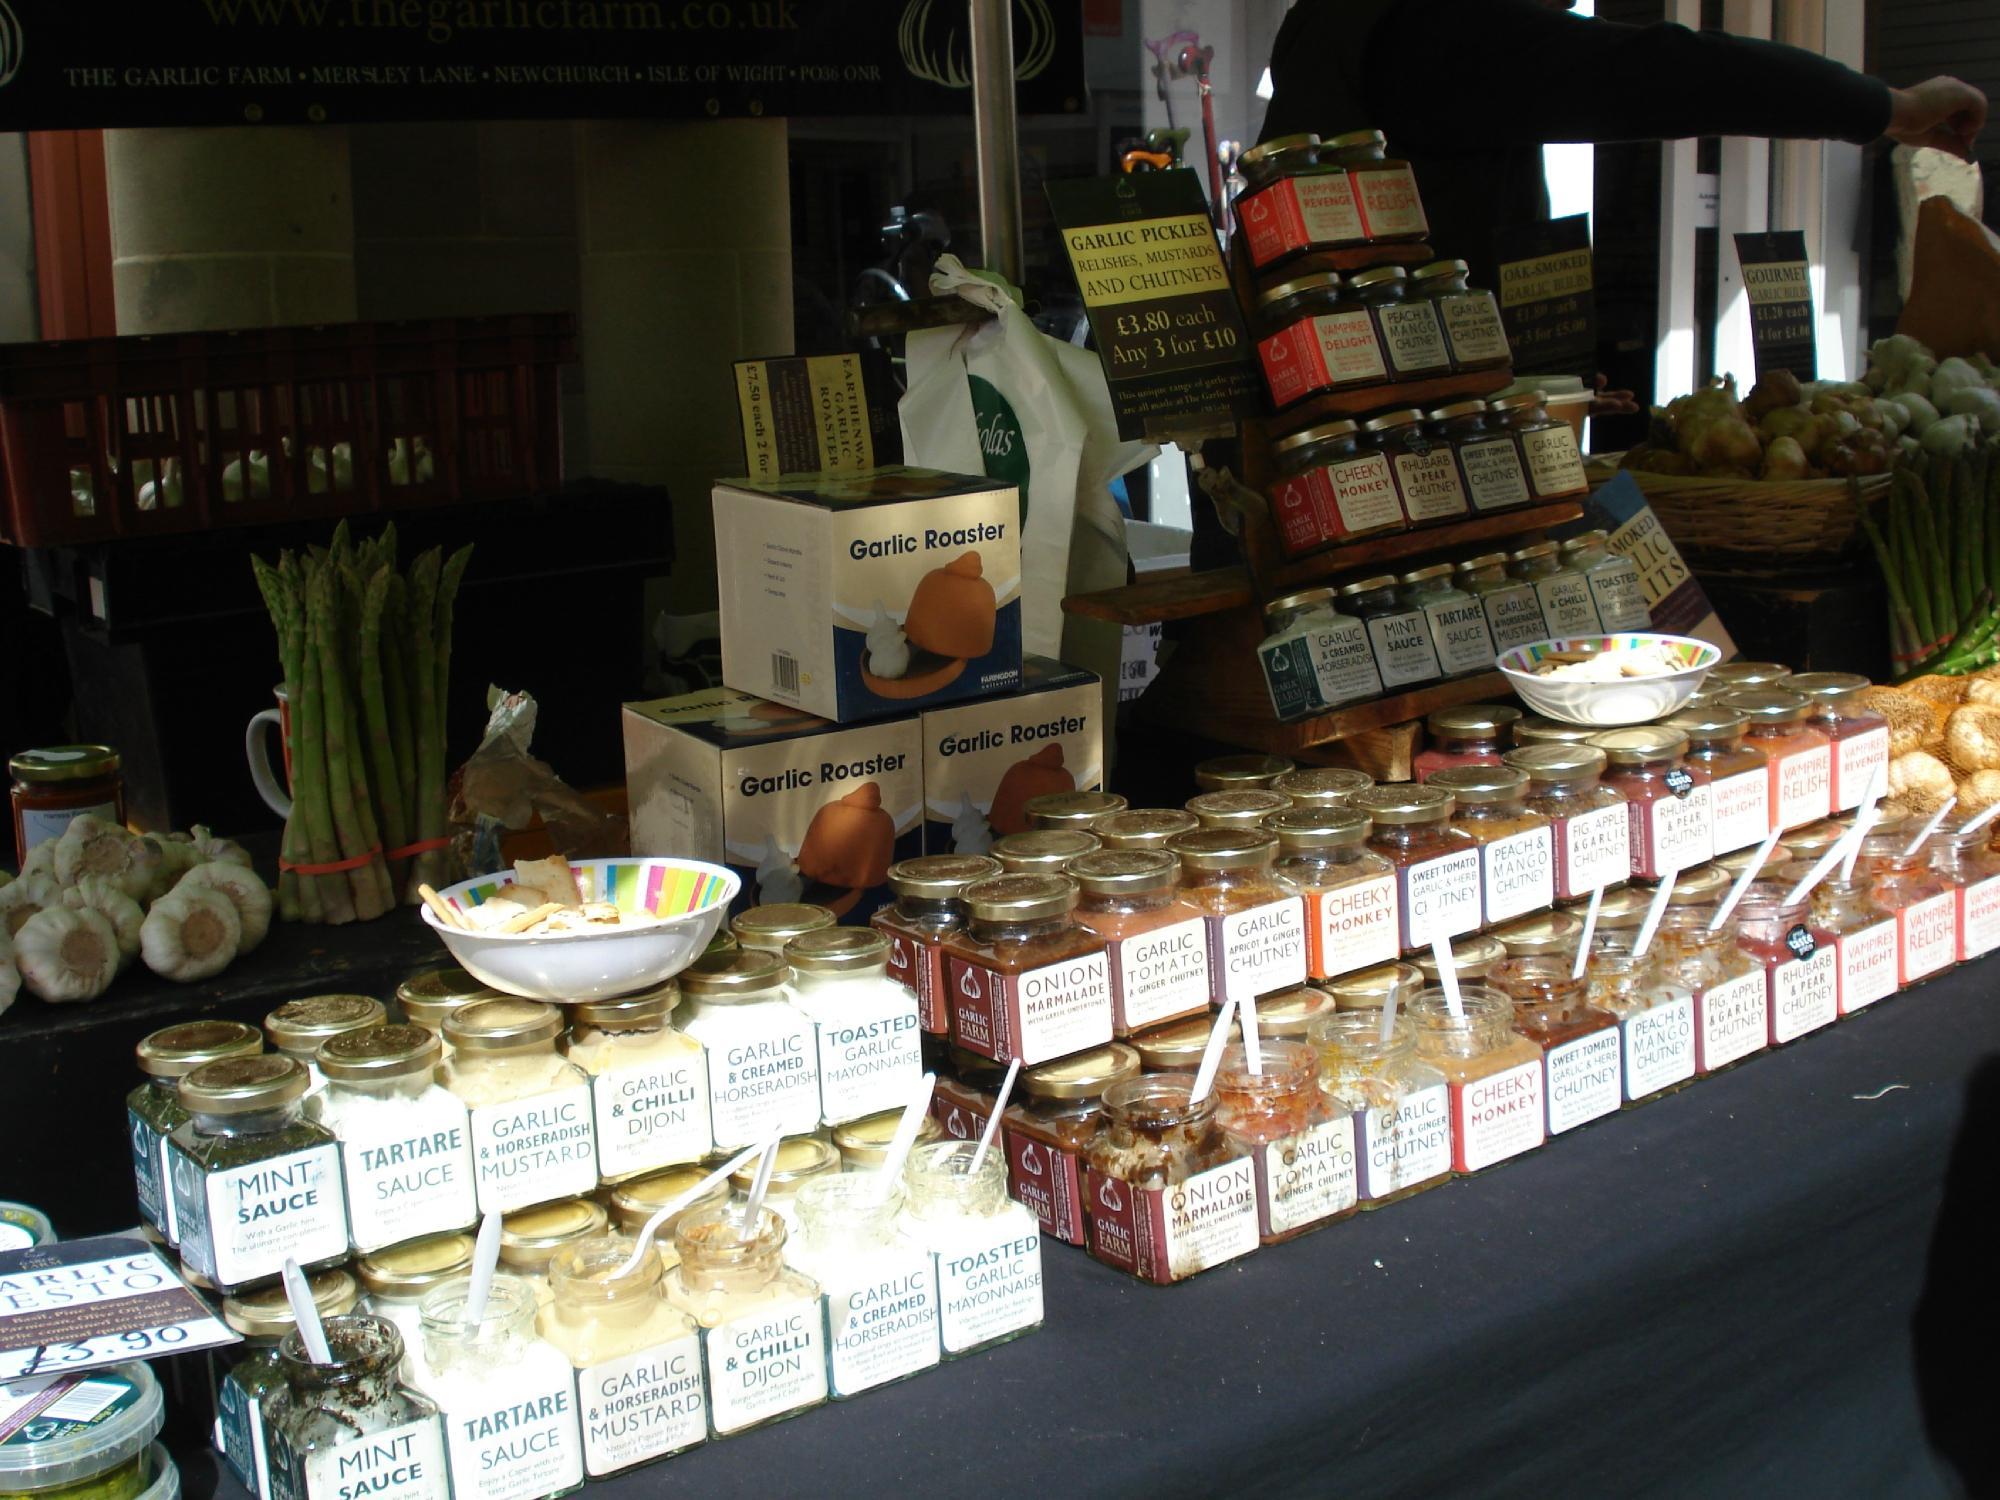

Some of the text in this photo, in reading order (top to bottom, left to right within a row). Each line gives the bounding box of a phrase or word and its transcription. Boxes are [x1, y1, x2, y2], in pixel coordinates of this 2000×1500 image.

[206, 0, 800, 44] www.thegarlicfarm.co.uk
[64, 67, 116, 88] THE
[125, 66, 220, 87] GARLIC
[227, 65, 293, 85] FARM
[312, 65, 410, 84] MERSLEY
[420, 65, 475, 83] LANE
[495, 64, 631, 83] NEWCHURCH
[649, 64, 692, 82] ISLE
[700, 64, 719, 82] OF
[726, 64, 787, 82] WIGHT
[1071, 222, 1208, 251] GARLIC PICKLES
[1146, 245, 1214, 266] MUSTARDS
[1087, 265, 1221, 296] AND CHUTNEYS
[1116, 304, 1216, 336] £3.80 each
[1112, 328, 1236, 368] Any 3 for £10
[1325, 335, 1374, 351] DELIGHT
[746, 365, 761, 401] £7.50
[753, 405, 765, 437] each
[820, 386, 838, 467] ROASTER
[835, 392, 850, 457] GARLIC
[759, 454, 768, 472] for
[1335, 462, 1385, 485] CHEEKY
[1471, 468, 1519, 485] CHUTNEY
[1339, 480, 1390, 498] MONKEY
[1407, 481, 1457, 499] CHUTNEY
[850, 523, 1005, 560] Garlic Roaster
[1436, 605, 1482, 627] TARTARE
[1497, 599, 1535, 615] GARLIC
[1559, 608, 1586, 621] DIJON
[1318, 628, 1362, 648] GARLIC
[1384, 618, 1416, 637] MINT
[1447, 627, 1482, 644] SAUCE
[1387, 637, 1424, 652] SAUCE
[980, 670, 1018, 683] FARINGDON
[939, 716, 1087, 756] Garlic Roaster
[740, 753, 906, 797] Garlic Roaster
[1783, 774, 1829, 801] RELISH
[1495, 835, 1544, 862] PEACH &
[1660, 823, 1710, 850] CHUTNEY
[1412, 857, 1476, 884] SWEET TOMATO
[1493, 850, 1548, 880] MANGO
[1574, 842, 1625, 868] CHUTNEY
[1496, 868, 1545, 894] CHUTNEY
[1329, 884, 1391, 916] CHEEKY
[1237, 909, 1291, 937] GARLIC
[1329, 907, 1392, 935] MONKEY
[1136, 933, 1193, 963] GARLIC
[1230, 940, 1301, 973] CHUTNEY
[1849, 949, 1893, 976] DELIGHT
[1025, 961, 1103, 998] ONION
[1128, 951, 1203, 984] TOMATO
[1783, 954, 1832, 984] RHUBARB
[1027, 983, 1105, 1015] MARMALADE
[1783, 984, 1833, 1015] CHUTNEY
[827, 1014, 917, 1047] TOASTED
[959, 1007, 988, 1026] GARLIC
[960, 1019, 990, 1042] FARM
[1635, 1007, 1687, 1037] PEACH &
[1710, 1010, 1764, 1043] CHUTNEY
[727, 1034, 803, 1066] GARLIC
[845, 1037, 903, 1061] GARLIC
[1552, 1036, 1617, 1069] SWEET TOMATO
[1634, 1022, 1689, 1055] MANGO
[728, 1056, 804, 1084] & CREAMED
[827, 1050, 920, 1084] MAYONNAISE
[1553, 1051, 1618, 1083] GARLIC & HERB
[1636, 1041, 1687, 1070] CHUTNEY
[622, 1069, 687, 1097] GARLIC
[714, 1069, 818, 1104] HORSERADISH
[1471, 1070, 1536, 1108] CHEEKY
[1554, 1066, 1618, 1102] CHUTNEY
[612, 1087, 694, 1118] & CHILLI
[1381, 1098, 1437, 1130] GARLIC
[1471, 1093, 1537, 1127] MONKEY
[492, 1103, 576, 1138] GARLIC
[629, 1108, 685, 1136] DIJON
[360, 1128, 462, 1172] TARTARE
[480, 1122, 590, 1158] & HORSERADISH
[1282, 1133, 1343, 1167] GARLIC
[1373, 1128, 1447, 1168] CHUTNEY
[482, 1141, 591, 1181] MUSTARD
[1273, 1151, 1353, 1189] TOMATO
[238, 1160, 313, 1201] MINT
[377, 1164, 454, 1200] SAUCE
[1020, 1183, 1050, 1201] GARLIC
[1171, 1167, 1250, 1211] ONION
[238, 1190, 318, 1224] SAUCE
[1021, 1194, 1052, 1220] FARM
[1171, 1189, 1253, 1229] MARMALADE
[1097, 1218, 1130, 1239] GARLIC
[946, 1235, 1038, 1277] TOASTED
[1098, 1234, 1132, 1257] FARM
[848, 1272, 924, 1311] GARLIC
[965, 1260, 1025, 1291] GARLIC
[948, 1272, 1041, 1315] MAYONNAISE
[849, 1293, 926, 1329] & CREAMED
[736, 1315, 802, 1349] GARLIC
[836, 1307, 938, 1352] HORSERADISH
[19, 1326, 188, 1376] £3.90
[726, 1332, 811, 1371] & CHILLI
[601, 1356, 686, 1397] GARLIC
[743, 1355, 801, 1388] DIJON
[588, 1374, 700, 1421] & HORSERADISH
[464, 1390, 568, 1442] TARTARE
[590, 1392, 701, 1443] MUSTARD
[339, 1434, 417, 1479] MINT
[481, 1427, 559, 1470] SAUCE
[339, 1463, 423, 1500] SAUCE
